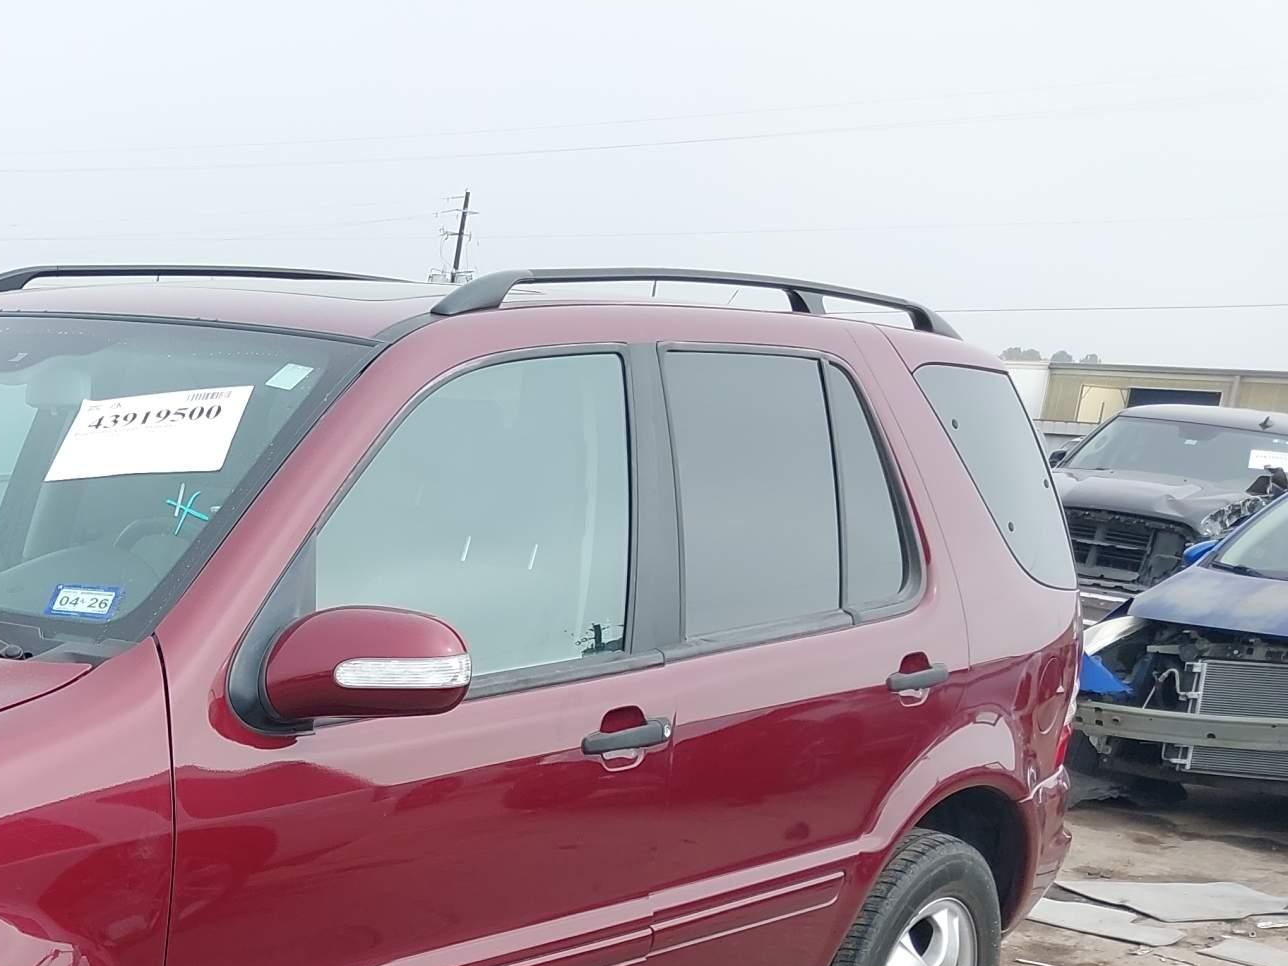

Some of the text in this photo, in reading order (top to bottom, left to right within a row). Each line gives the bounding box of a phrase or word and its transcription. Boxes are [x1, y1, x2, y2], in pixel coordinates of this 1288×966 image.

[88, 404, 223, 430] 43919500
[59, 595, 110, 610] 04 26
